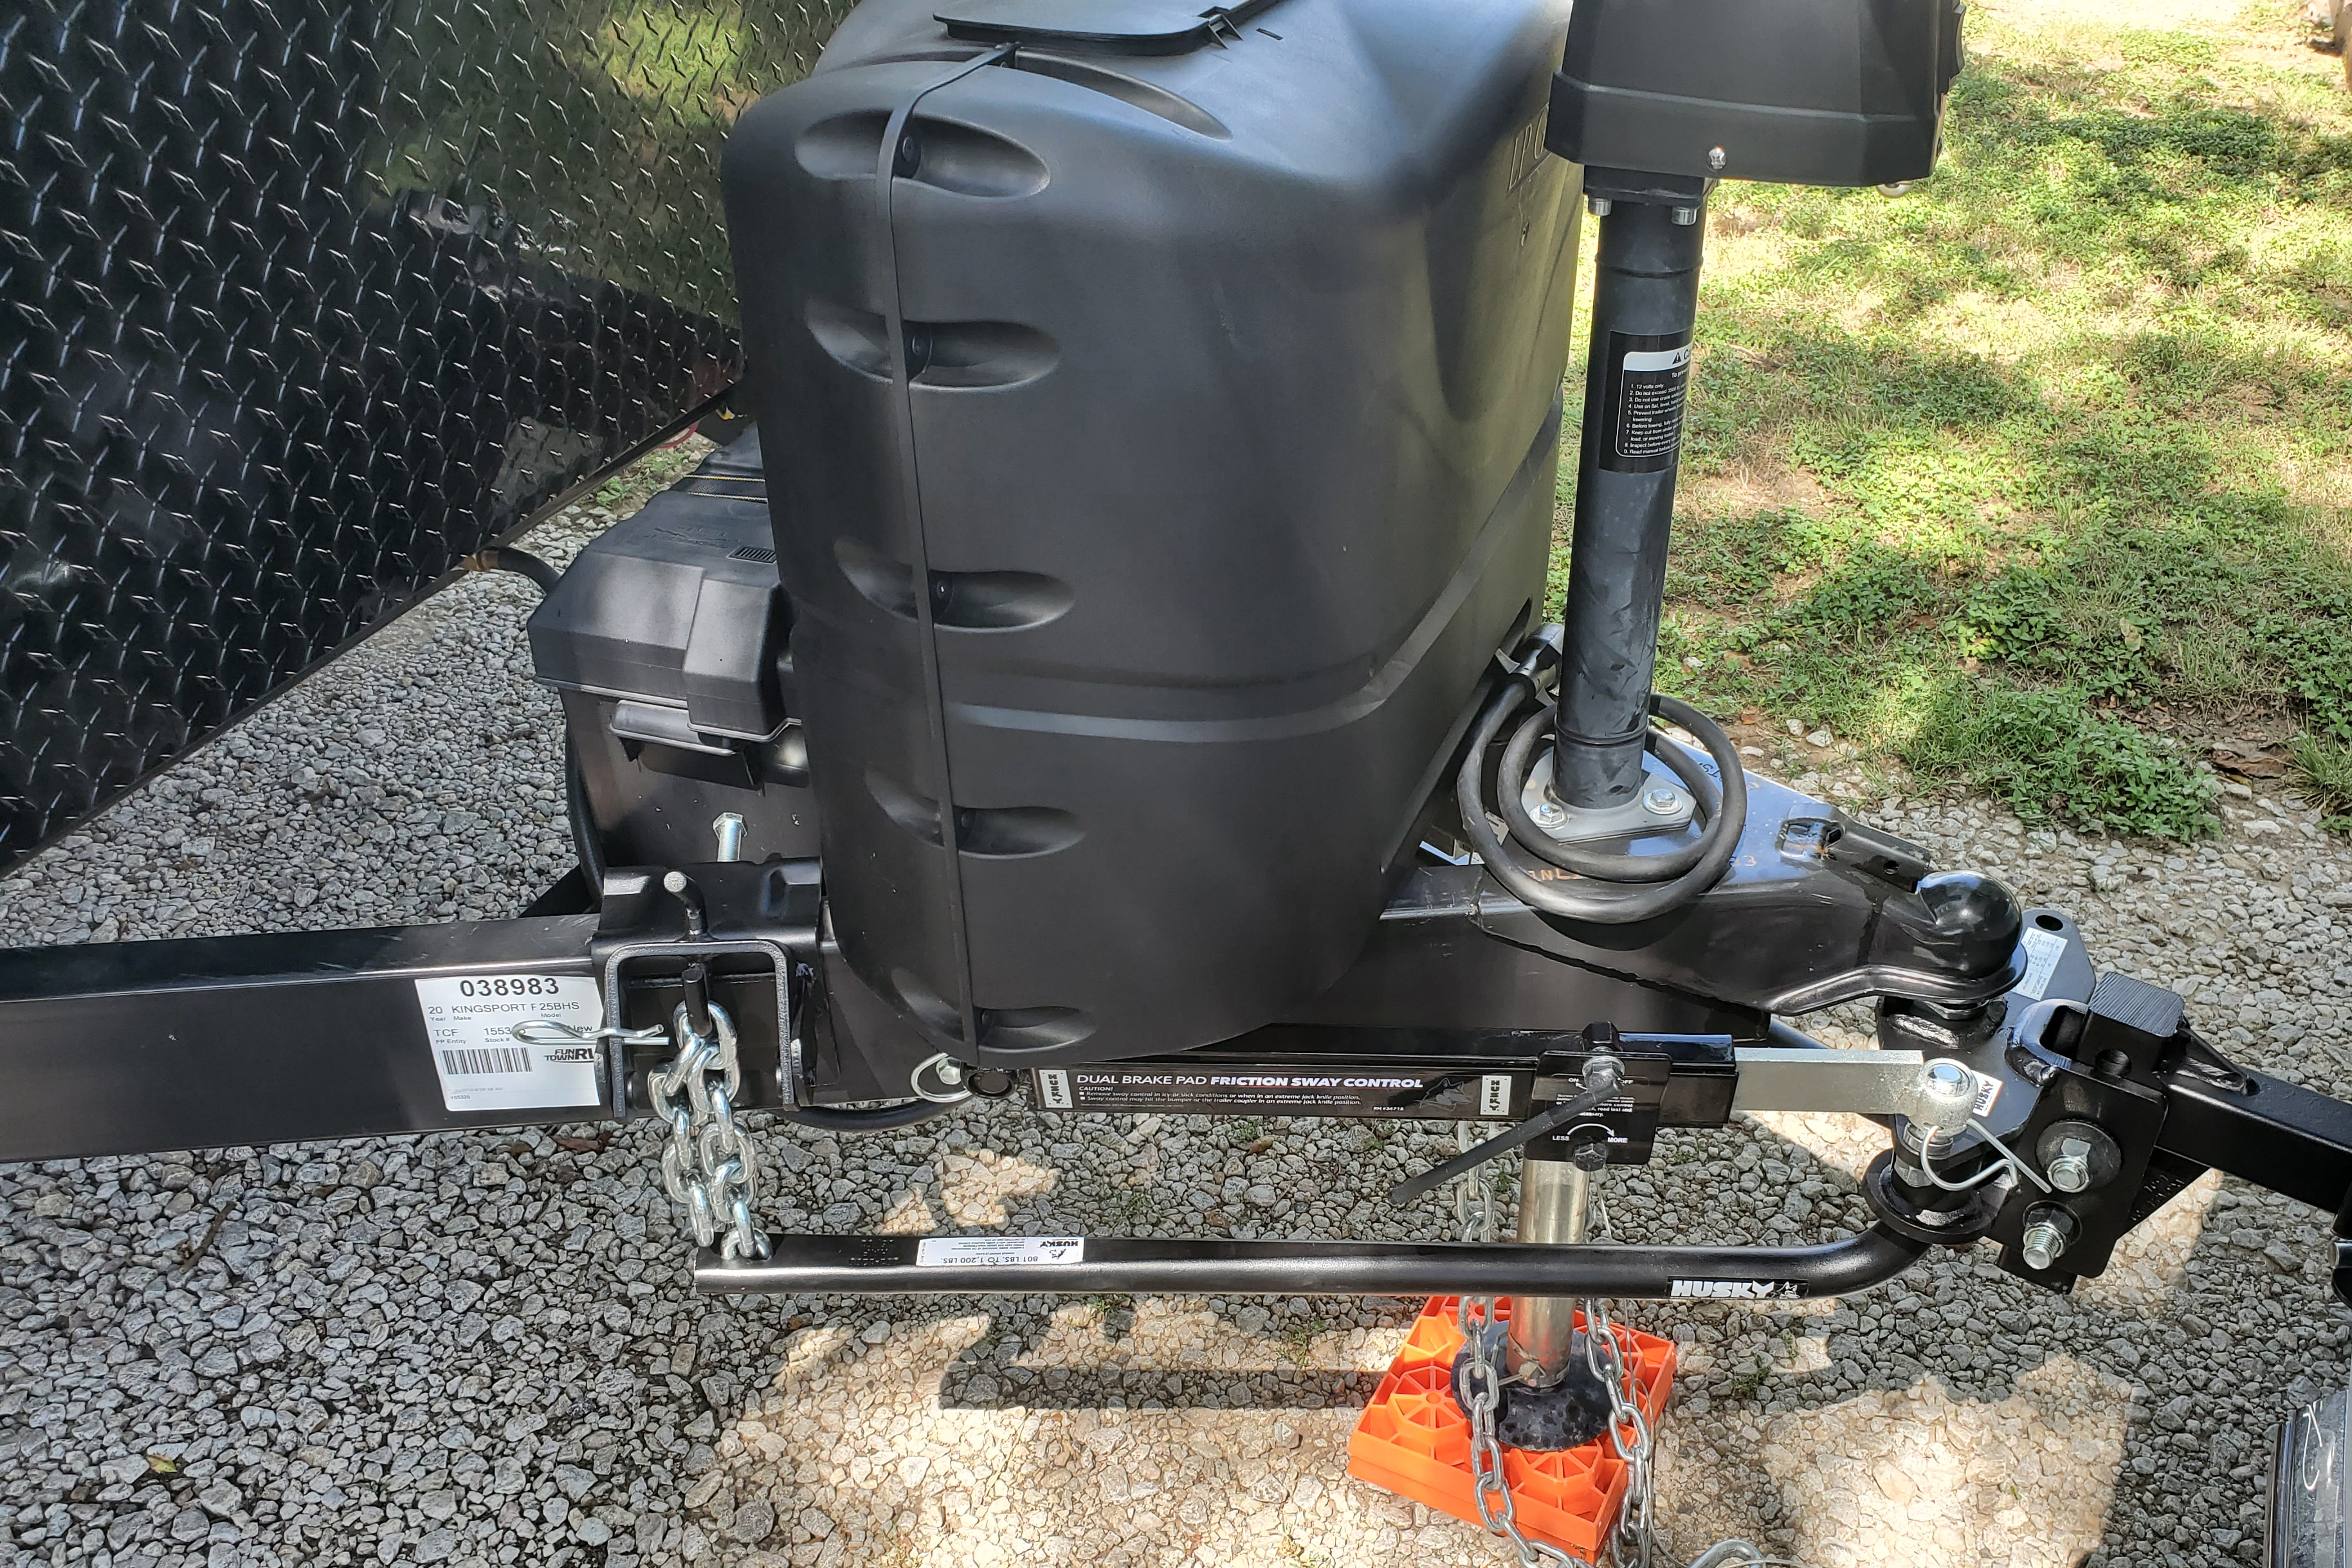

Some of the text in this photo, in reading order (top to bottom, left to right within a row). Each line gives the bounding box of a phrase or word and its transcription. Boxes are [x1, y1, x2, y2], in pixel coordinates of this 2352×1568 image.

[460, 978, 560, 997] 038983
[428, 1006, 442, 1014] 20
[451, 1003, 527, 1014] KINGSPORT
[539, 1002, 579, 1010] 25BHS
[1077, 1075, 1423, 1088] DUAL BRAKE PAD FRICTION SWAY CONTROL
[1974, 1079, 1994, 1111] HUSKY
[1671, 1280, 1774, 1299] HUSKY
